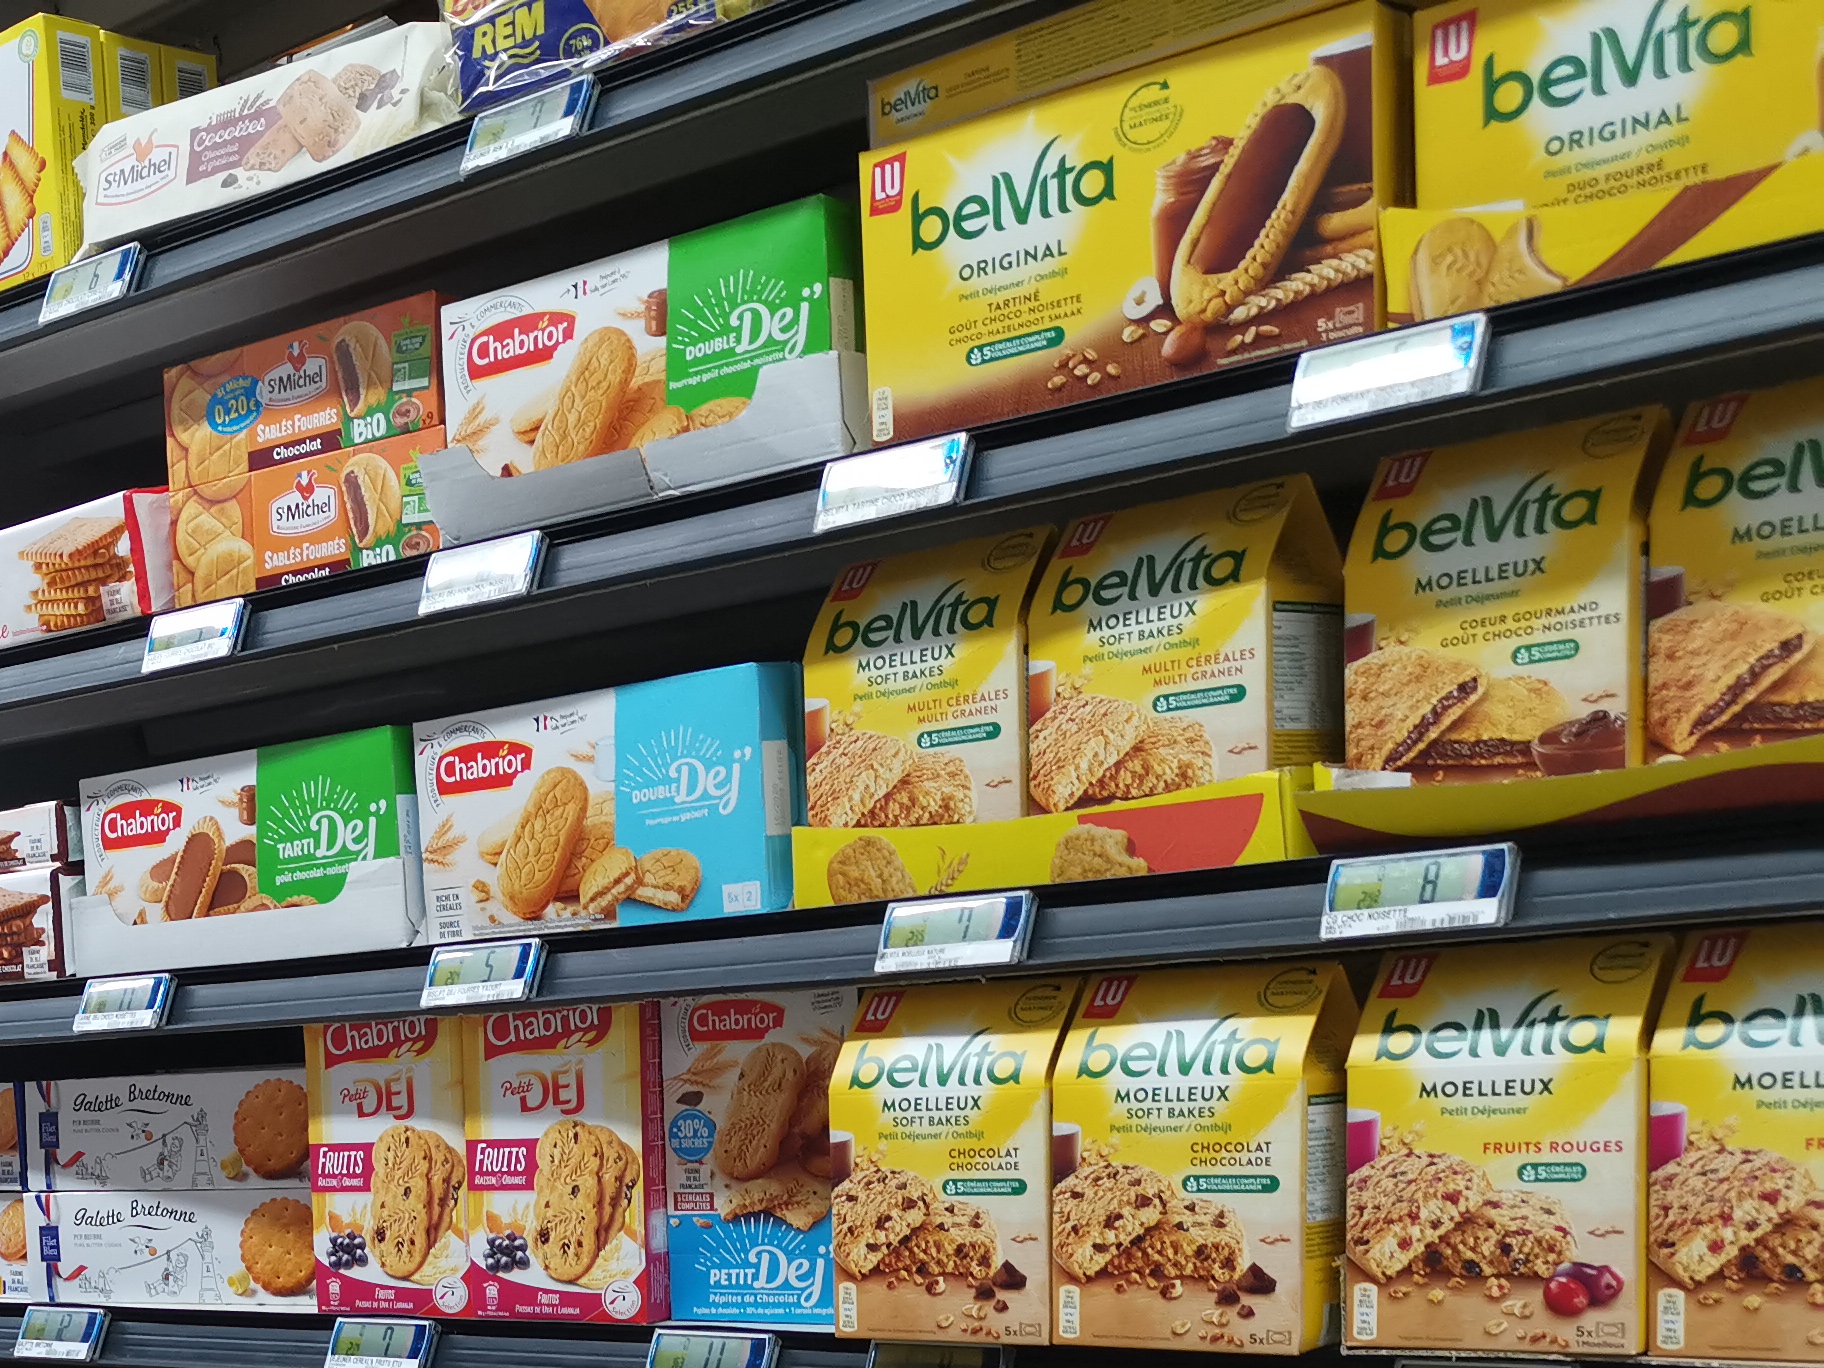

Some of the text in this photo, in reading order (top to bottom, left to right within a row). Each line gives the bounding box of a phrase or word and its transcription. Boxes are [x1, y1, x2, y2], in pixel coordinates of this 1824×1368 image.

[1482, 0, 1754, 129] belVita
[194, 118, 266, 148] Cocottes
[1544, 103, 1690, 156] ORIGINAL
[911, 135, 1117, 255] belVita
[959, 240, 1068, 282] ORIGINAL
[948, 294, 1082, 336] GOÛT CHOCO-NOISETTE
[987, 290, 1040, 313] TARTINÉ
[948, 317, 1044, 347] CHOCO-HAZELNOOT
[1047, 308, 1083, 325] SMAAK
[473, 322, 567, 364] Chabrior
[685, 339, 737, 360] DOUBLE
[273, 439, 322, 459] Chocolat
[1371, 470, 1603, 563] belVita
[1050, 532, 1248, 616] belVita
[1415, 556, 1546, 594] MOELLEUX
[1087, 600, 1197, 634] MOELLEUX
[1440, 614, 1621, 648] GOÛT CHOCO-NOISETTES
[1460, 601, 1599, 631] COEUR GOURMAND
[1098, 623, 1184, 647] SOFT BAKES
[1141, 648, 1256, 676] MULTI CÉRÉALES
[439, 750, 525, 782] Chabrior
[632, 783, 678, 804] DOUBLE
[105, 809, 177, 839] Chabrior
[276, 841, 314, 858] TARTI
[693, 1008, 776, 1031] Chabrior
[1375, 990, 1610, 1062] belVita
[1077, 1013, 1280, 1079] belVita
[72, 1084, 193, 1117] Galette Bretonne
[340, 1085, 369, 1106] Petit
[1115, 1086, 1230, 1103] MOELLEUX
[1419, 1078, 1553, 1098] MOELLEUX
[1126, 1106, 1215, 1119] SOFT BAKES
[672, 1119, 708, 1139] -30%
[1190, 1141, 1271, 1154] CHOCOLAT
[1190, 1156, 1271, 1167] CHOCOLADE
[1483, 1139, 1623, 1155] FRUITS ROUGES
